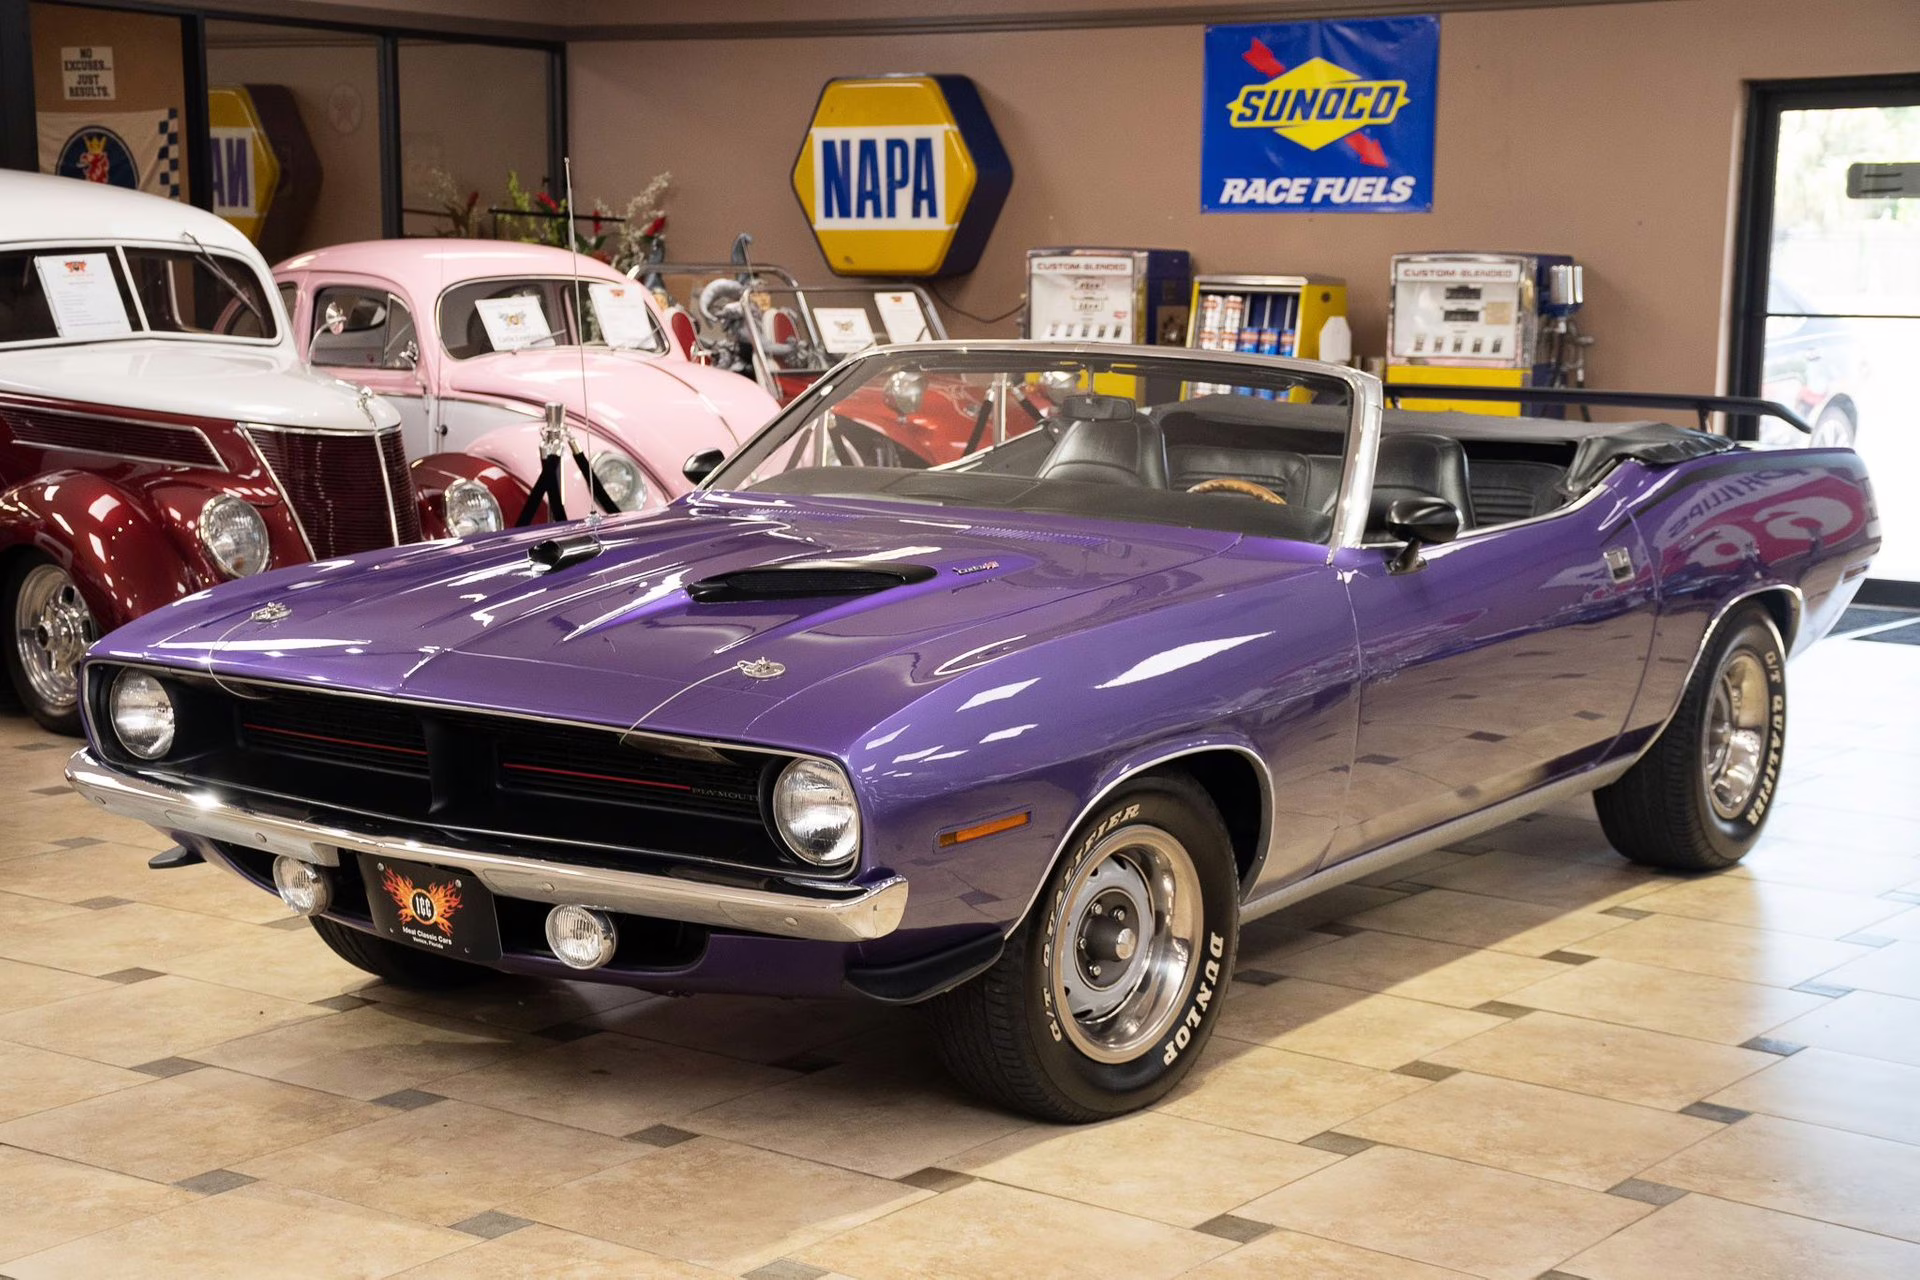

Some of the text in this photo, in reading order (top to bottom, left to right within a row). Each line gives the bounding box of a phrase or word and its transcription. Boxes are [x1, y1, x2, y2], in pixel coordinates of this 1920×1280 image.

[77, 74, 99, 85] JUST
[1237, 86, 1400, 121] SUNOCO
[822, 138, 937, 218] NAPA
[1220, 176, 1416, 205] RACE FUELS
[402, 926, 452, 945] Ideal Classic Cars
[1163, 931, 1225, 1066] DUNLOP
